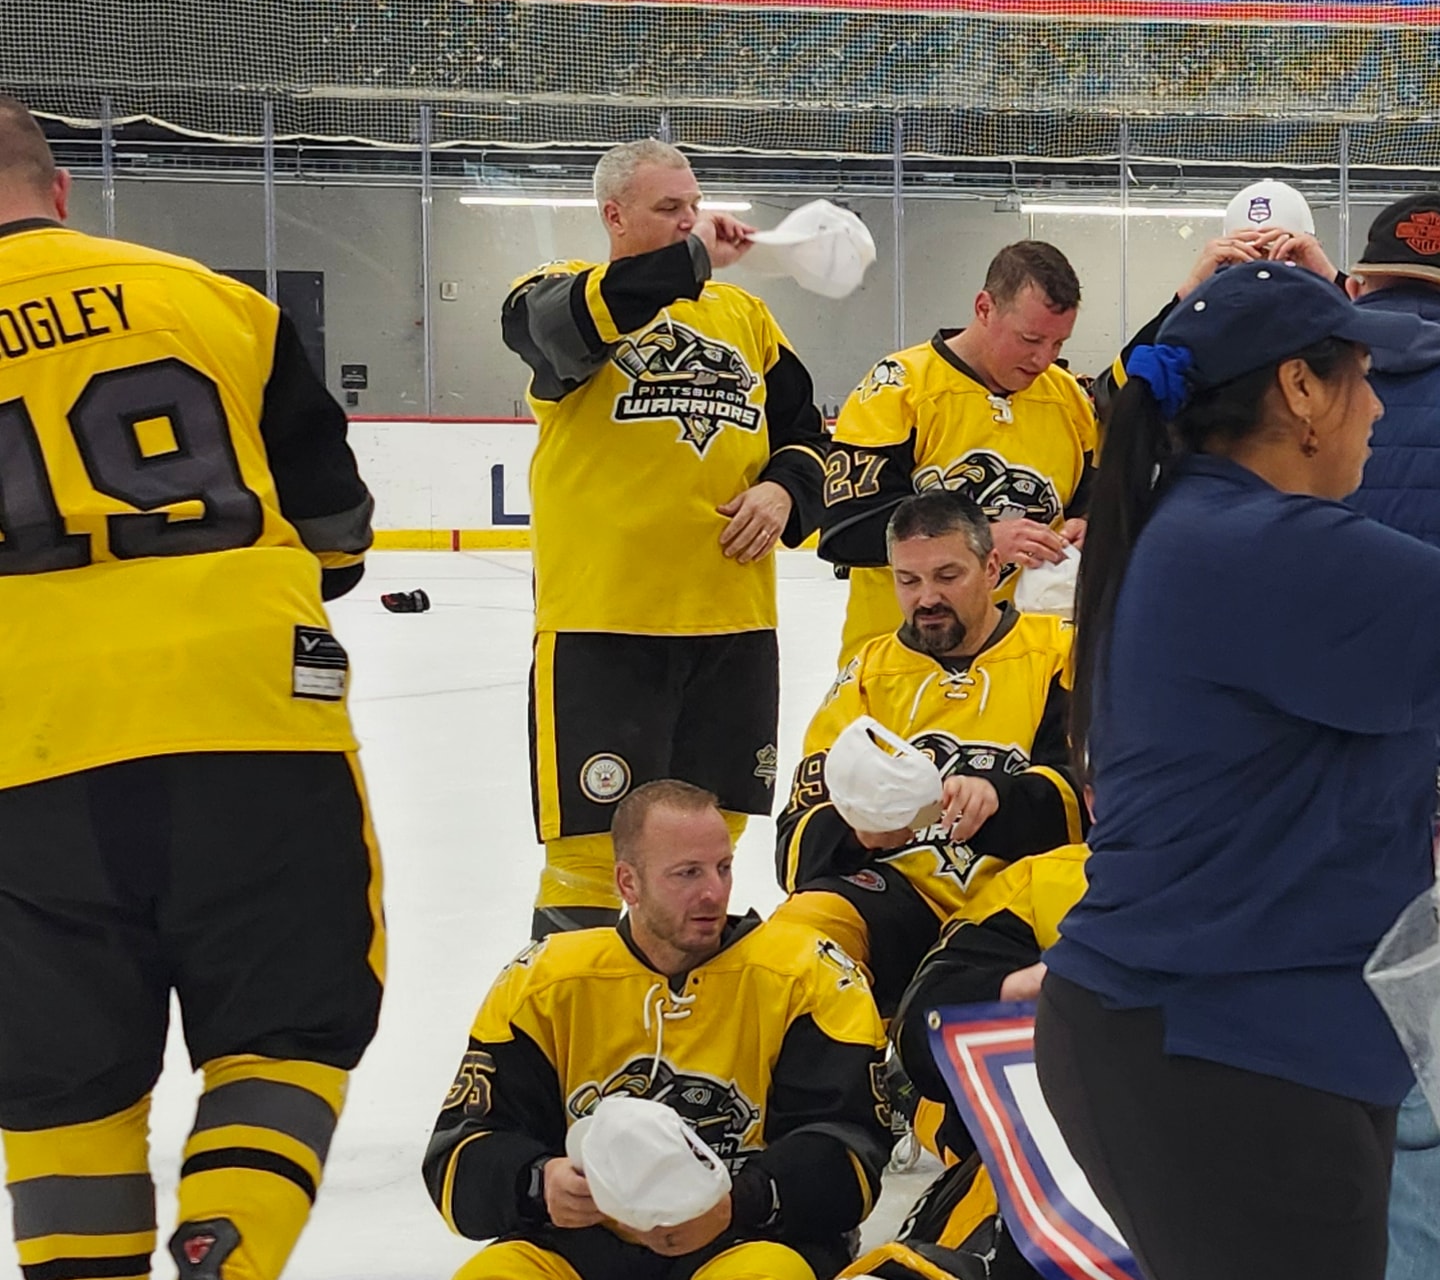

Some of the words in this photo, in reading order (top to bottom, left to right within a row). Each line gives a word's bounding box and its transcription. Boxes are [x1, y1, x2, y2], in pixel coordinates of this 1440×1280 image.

[0, 284, 130, 359] OGLEY
[623, 398, 756, 426] WARRIORS
[639, 386, 743, 405] PITTSBURGH
[0, 357, 264, 577] 19
[824, 450, 889, 508] 27
